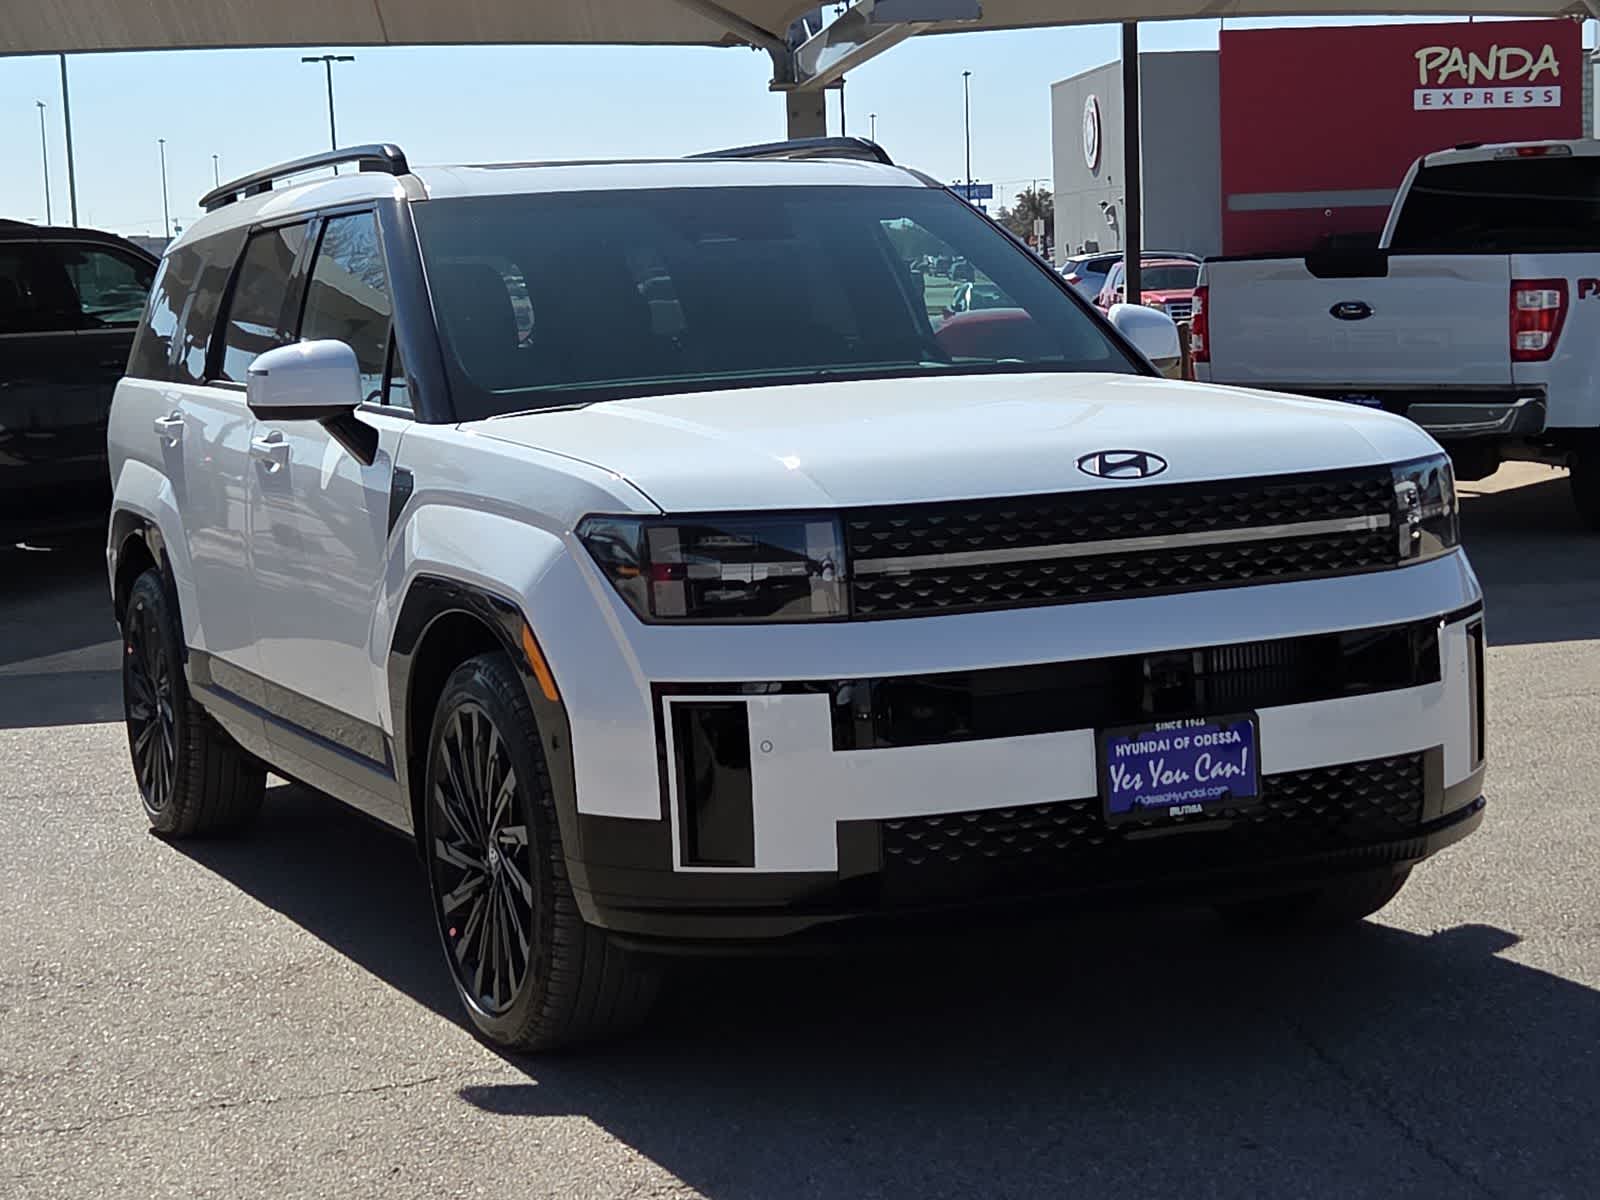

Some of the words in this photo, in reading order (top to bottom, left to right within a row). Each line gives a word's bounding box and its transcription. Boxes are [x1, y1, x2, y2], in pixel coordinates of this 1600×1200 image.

[1414, 44, 1560, 85] PANDA
[1422, 90, 1553, 105] EXPRESS
[1155, 719, 1182, 731] SINCE
[1115, 738, 1170, 757] HYUNDAI
[1174, 736, 1190, 750] OF
[1193, 730, 1241, 747] ODESSA
[1110, 763, 1144, 793] Yes
[1149, 758, 1189, 788] You
[1194, 747, 1248, 782] Can!
